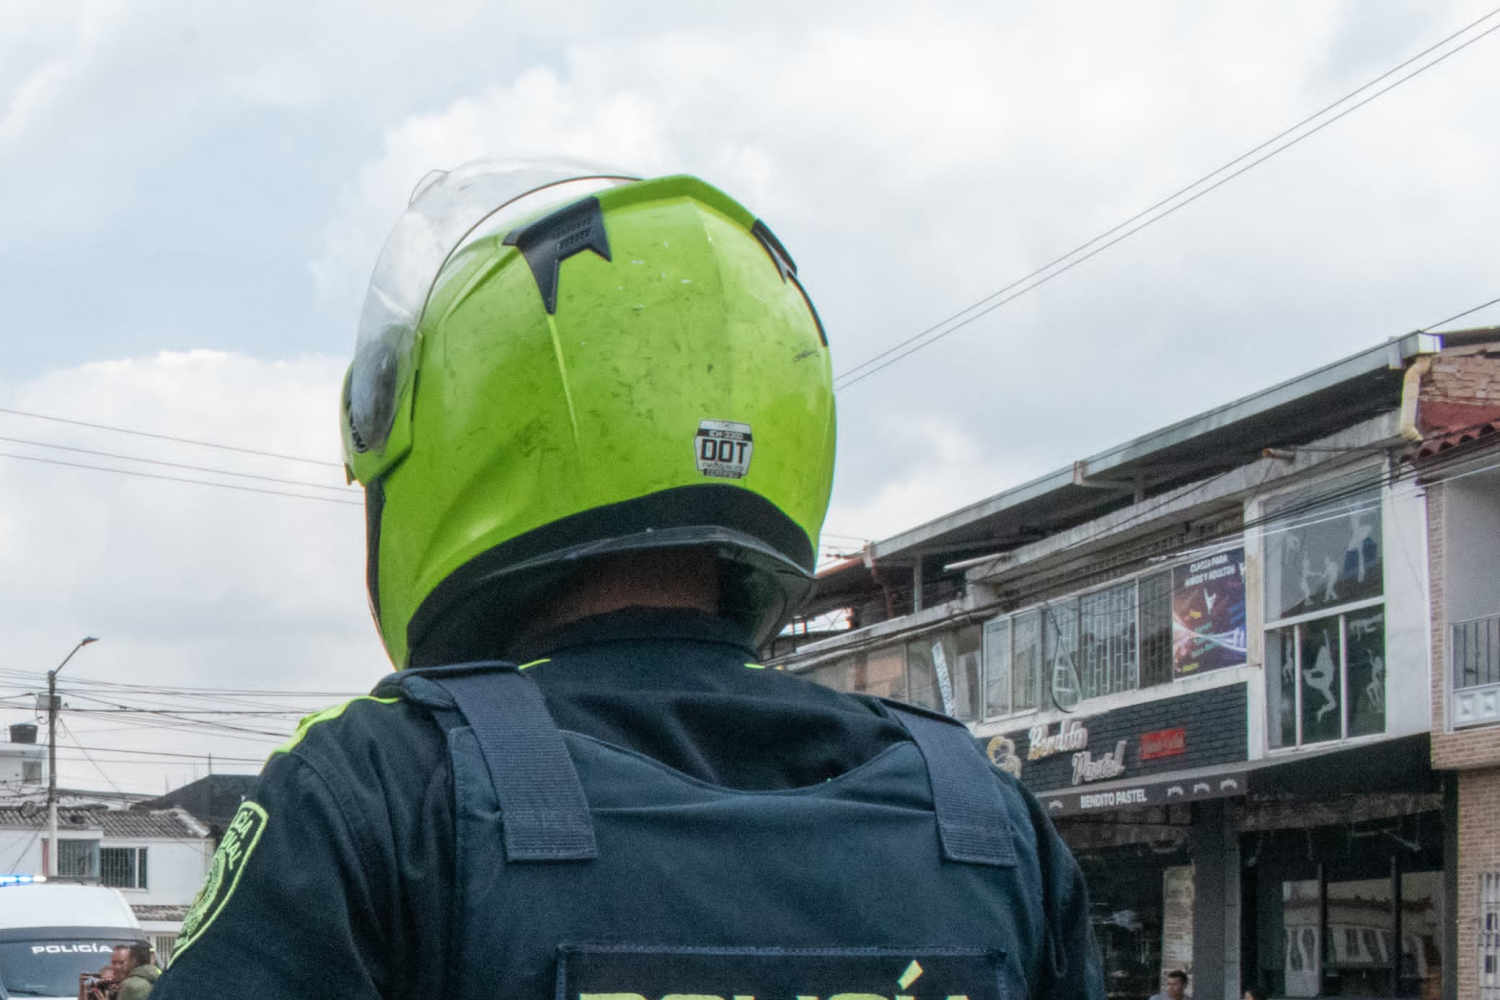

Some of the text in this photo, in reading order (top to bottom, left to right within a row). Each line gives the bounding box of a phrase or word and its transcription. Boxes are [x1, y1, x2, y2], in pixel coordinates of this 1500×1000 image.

[701, 438, 748, 464] DOT
[1028, 719, 1088, 760] Bendito
[1071, 740, 1127, 785] Pastel
[1080, 788, 1148, 808] BENDITO PASTEL
[31, 943, 113, 954] POLICÍA
